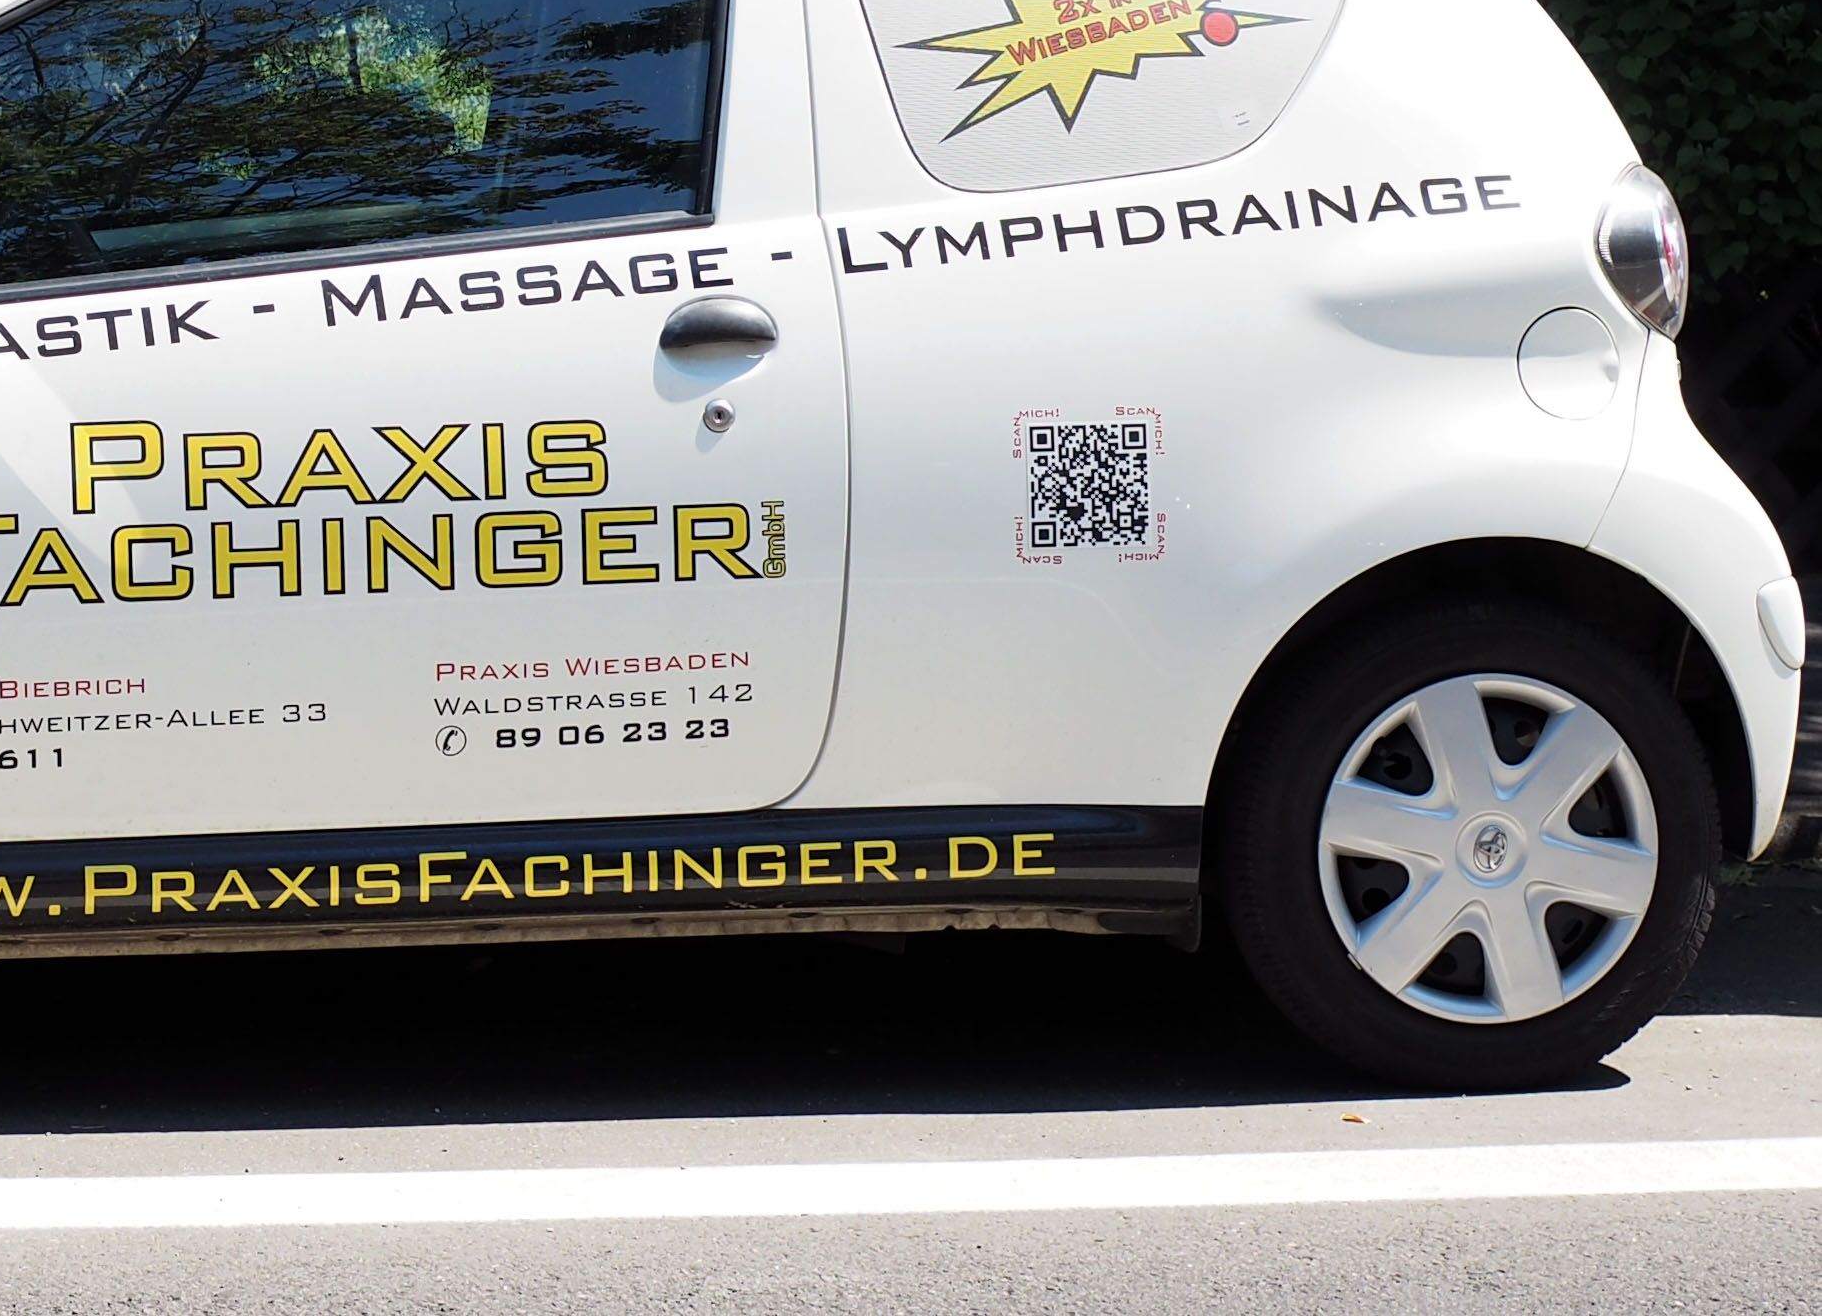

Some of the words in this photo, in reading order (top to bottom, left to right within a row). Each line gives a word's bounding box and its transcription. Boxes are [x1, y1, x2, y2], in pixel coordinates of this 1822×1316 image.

[320, 246, 734, 328] MASSAGE
[838, 174, 1521, 274] LYMPHDRAINAGE
[1115, 406, 1155, 416] SCAN
[71, 419, 609, 515] PRAXIS
[762, 499, 786, 580] GmbH
[436, 663, 550, 682] PRAXIS
[565, 652, 750, 677] WIESBADEN
[282, 703, 328, 724] 33
[434, 690, 668, 716] WALDSTRASSE
[687, 683, 753, 705] 142
[495, 727, 541, 748] 89
[558, 724, 605, 745] 06
[622, 722, 668, 743] 23
[684, 718, 730, 740] 23
